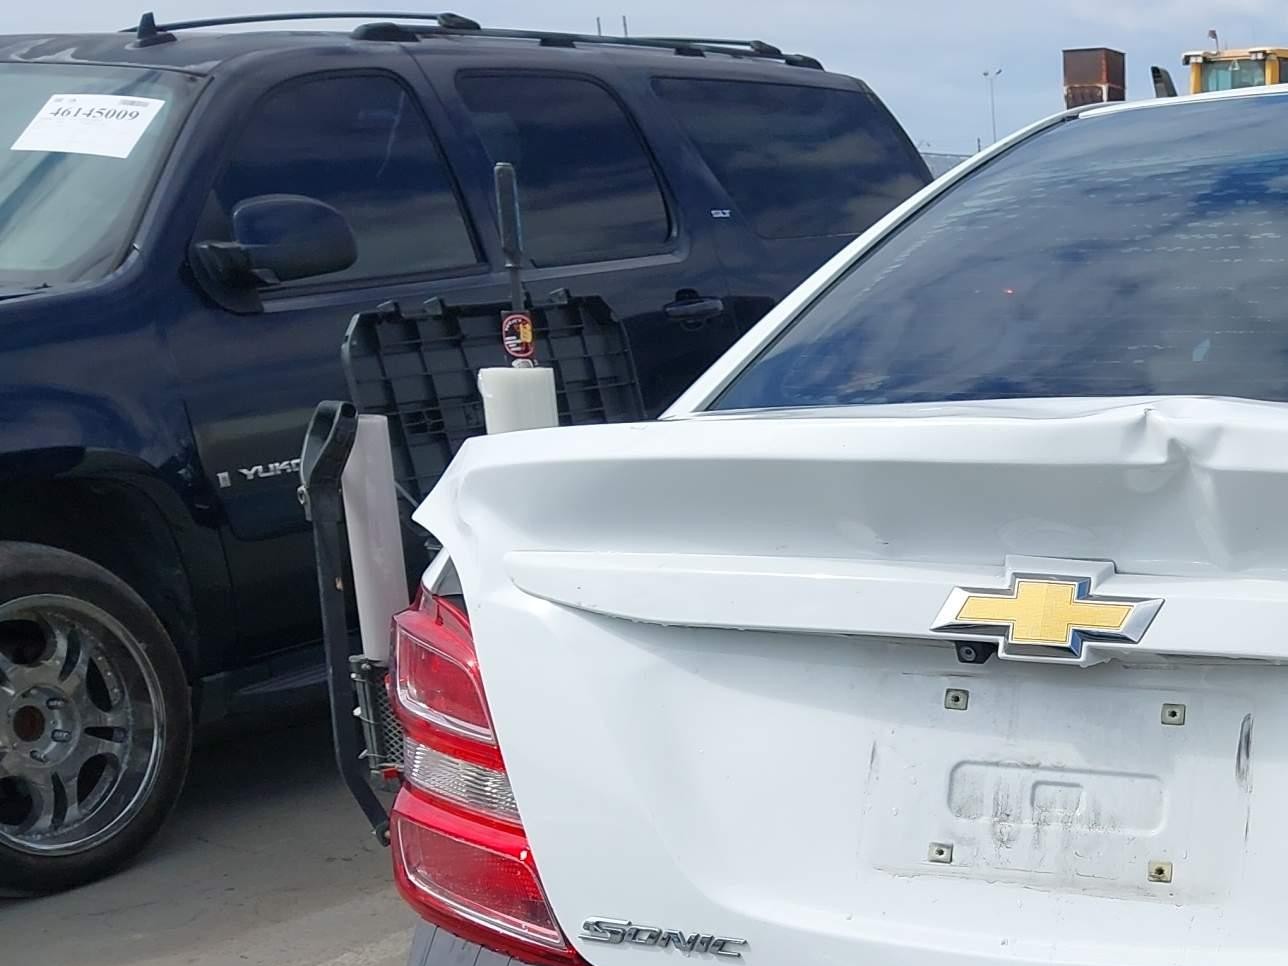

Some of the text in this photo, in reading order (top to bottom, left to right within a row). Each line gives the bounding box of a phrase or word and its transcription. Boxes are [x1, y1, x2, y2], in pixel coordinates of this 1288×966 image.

[49, 106, 140, 121] 46145009
[711, 209, 731, 218] SLT
[238, 458, 301, 480] YUKO
[578, 916, 750, 958] SONIC
